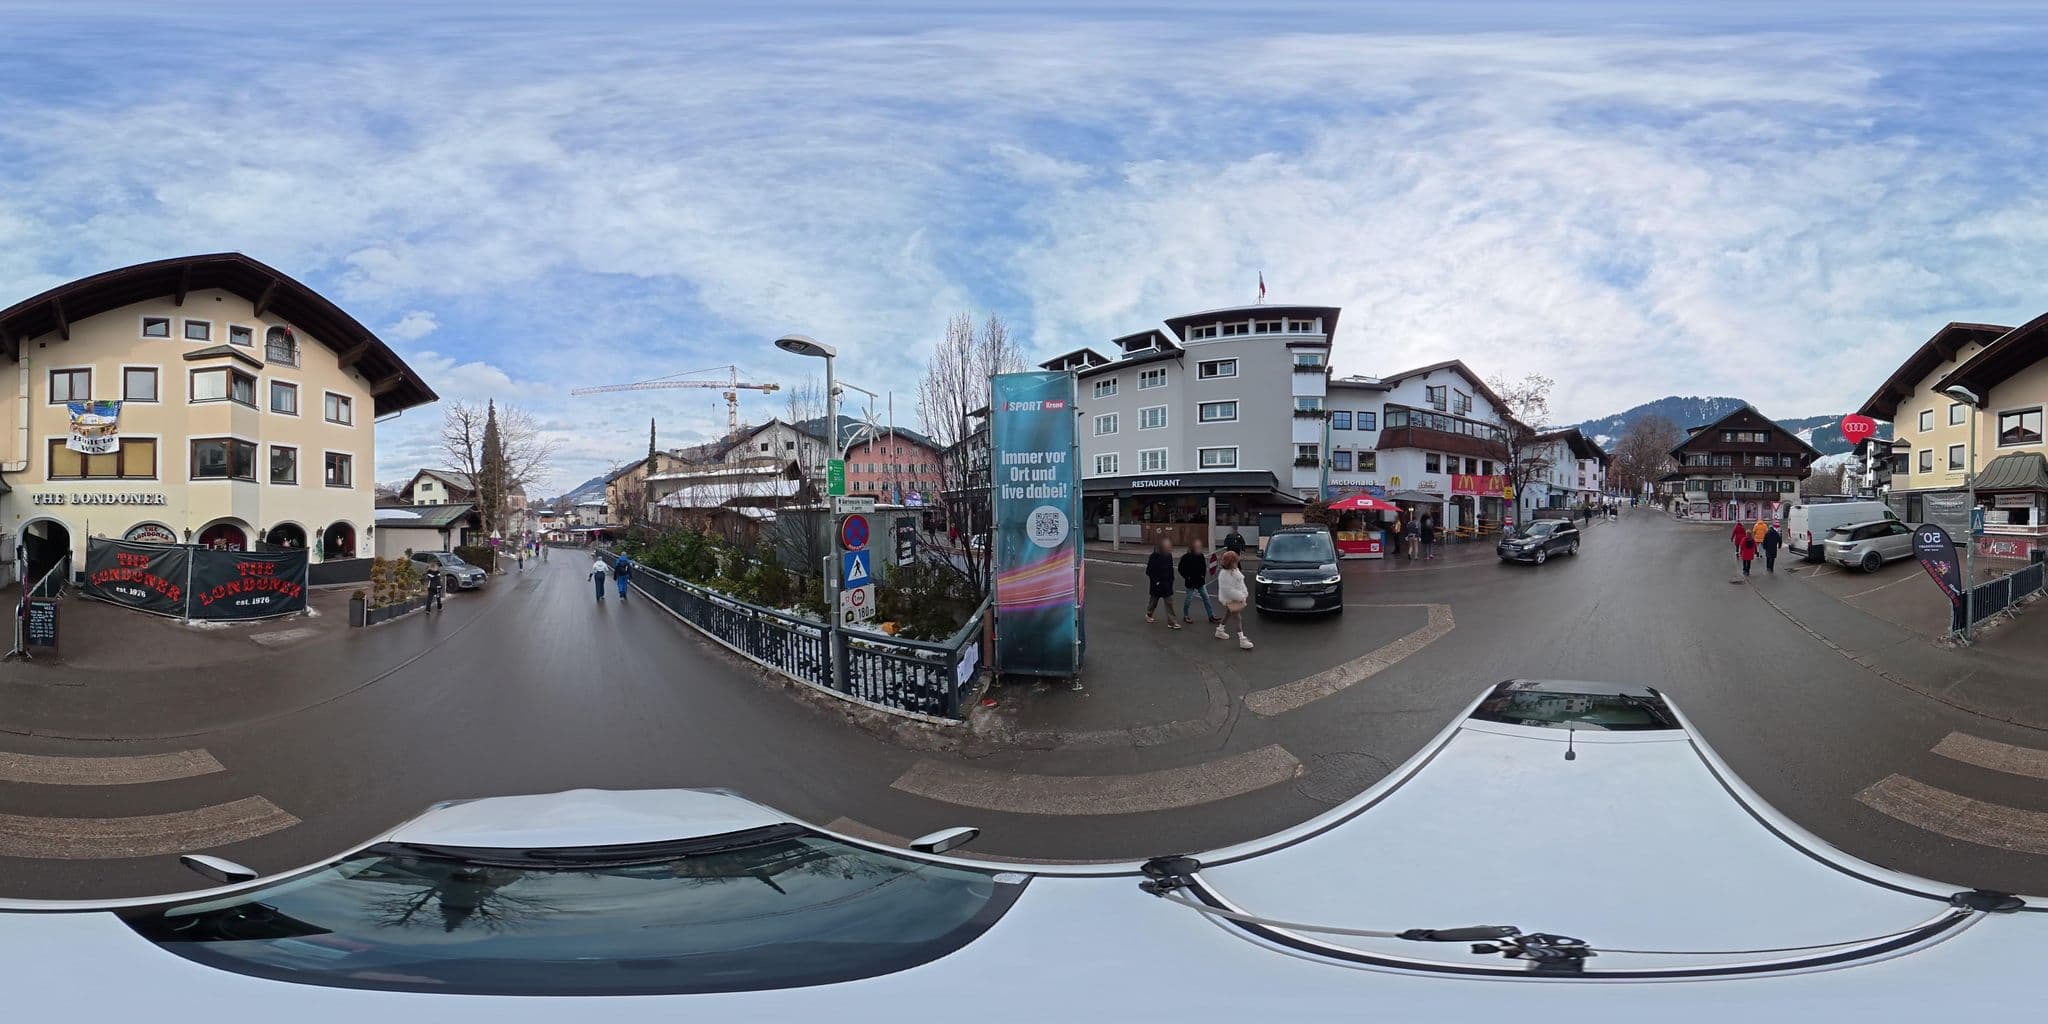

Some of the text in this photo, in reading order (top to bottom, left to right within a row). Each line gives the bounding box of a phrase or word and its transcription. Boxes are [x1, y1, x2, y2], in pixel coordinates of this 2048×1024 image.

[1009, 401, 1064, 411] SPORT Krone
[1001, 451, 1066, 465] Immer vor
[1010, 466, 1056, 481] Ort und
[1001, 482, 1067, 499] live dabei!
[1131, 479, 1181, 488] RESTAURANT
[32, 493, 167, 506] THE LONDONER
[116, 552, 150, 569] THE
[236, 561, 276, 576] THE
[91, 567, 183, 603] LONDONER
[116, 586, 128, 594] est.
[199, 577, 302, 607] LONDONER
[235, 596, 270, 606] est. 1976
